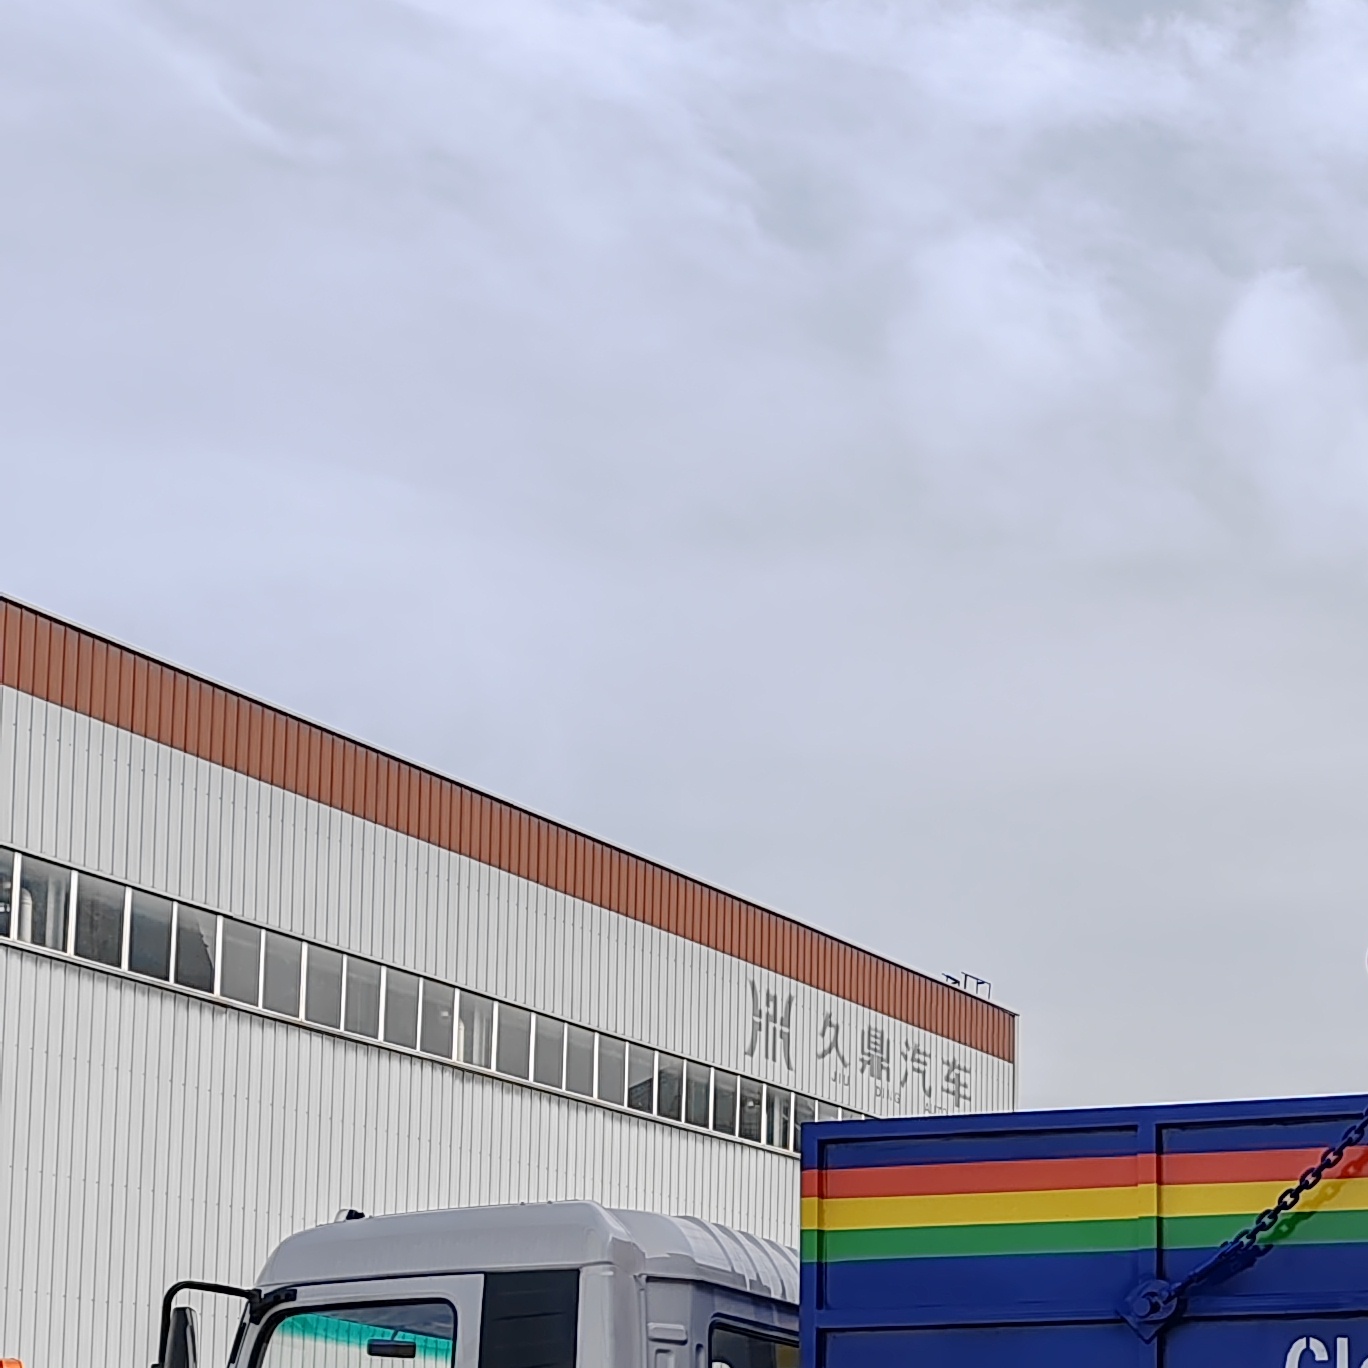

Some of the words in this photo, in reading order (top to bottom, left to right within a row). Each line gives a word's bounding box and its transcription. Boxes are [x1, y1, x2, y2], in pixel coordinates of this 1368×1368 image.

[816, 1011, 972, 1108] 久鼎汽车
[831, 1070, 851, 1087] JIU
